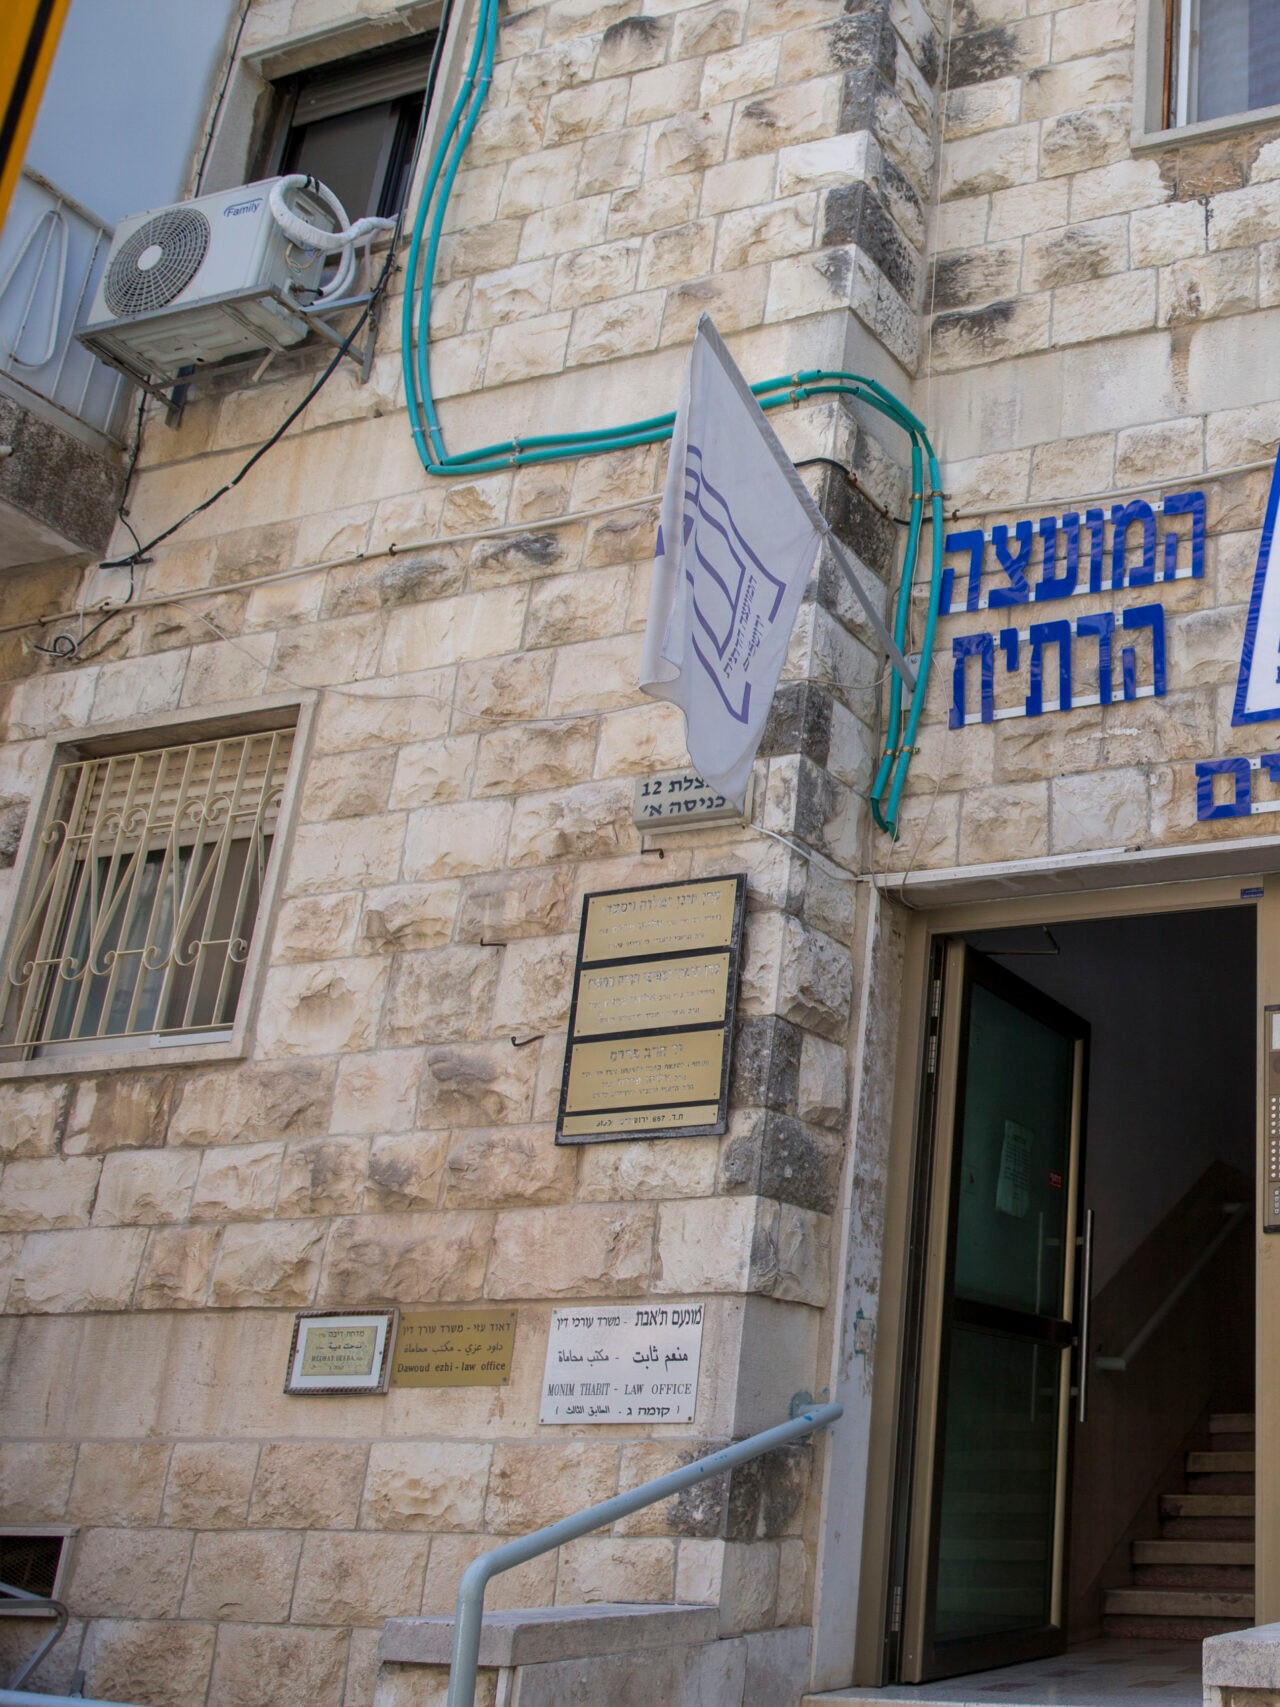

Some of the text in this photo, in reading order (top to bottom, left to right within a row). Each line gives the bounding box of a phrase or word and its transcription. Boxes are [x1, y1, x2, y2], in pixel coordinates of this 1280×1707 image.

[225, 200, 261, 217] Family
[939, 491, 1205, 616] המועצה
[723, 574, 758, 679] המועצה הדתית
[742, 614, 765, 673] ירושלים
[948, 603, 1167, 729] הדתית
[641, 776, 709, 796] צלת 12
[643, 796, 726, 816] כניסה א'
[557, 1318, 568, 1330] דין
[572, 1317, 594, 1328] עורכי
[597, 1316, 621, 1327] משרד
[635, 1308, 668, 1327] ת'אבת
[671, 1307, 702, 1328] מונעם
[402, 1325, 414, 1336] דין
[418, 1325, 438, 1336] עורך
[440, 1324, 464, 1333] משרד
[473, 1324, 486, 1332] עזי
[489, 1323, 511, 1331] דאוד
[431, 1341, 454, 1354] مكتب
[465, 1344, 482, 1355] عزي
[486, 1343, 503, 1353] داود
[558, 1349, 583, 1363] محاماة
[587, 1349, 609, 1366] مكتب
[633, 1345, 659, 1369] ثابت
[665, 1347, 688, 1372] منعم
[397, 1363, 430, 1373] Dawoud
[461, 1362, 476, 1371] law
[480, 1361, 506, 1371] office
[547, 1383, 575, 1396] MONIM
[580, 1383, 610, 1396] THABIT
[624, 1384, 645, 1395] LAW
[651, 1383, 692, 1395] OFFICE
[626, 1407, 633, 1416] ג
[638, 1406, 671, 1417] קומה
